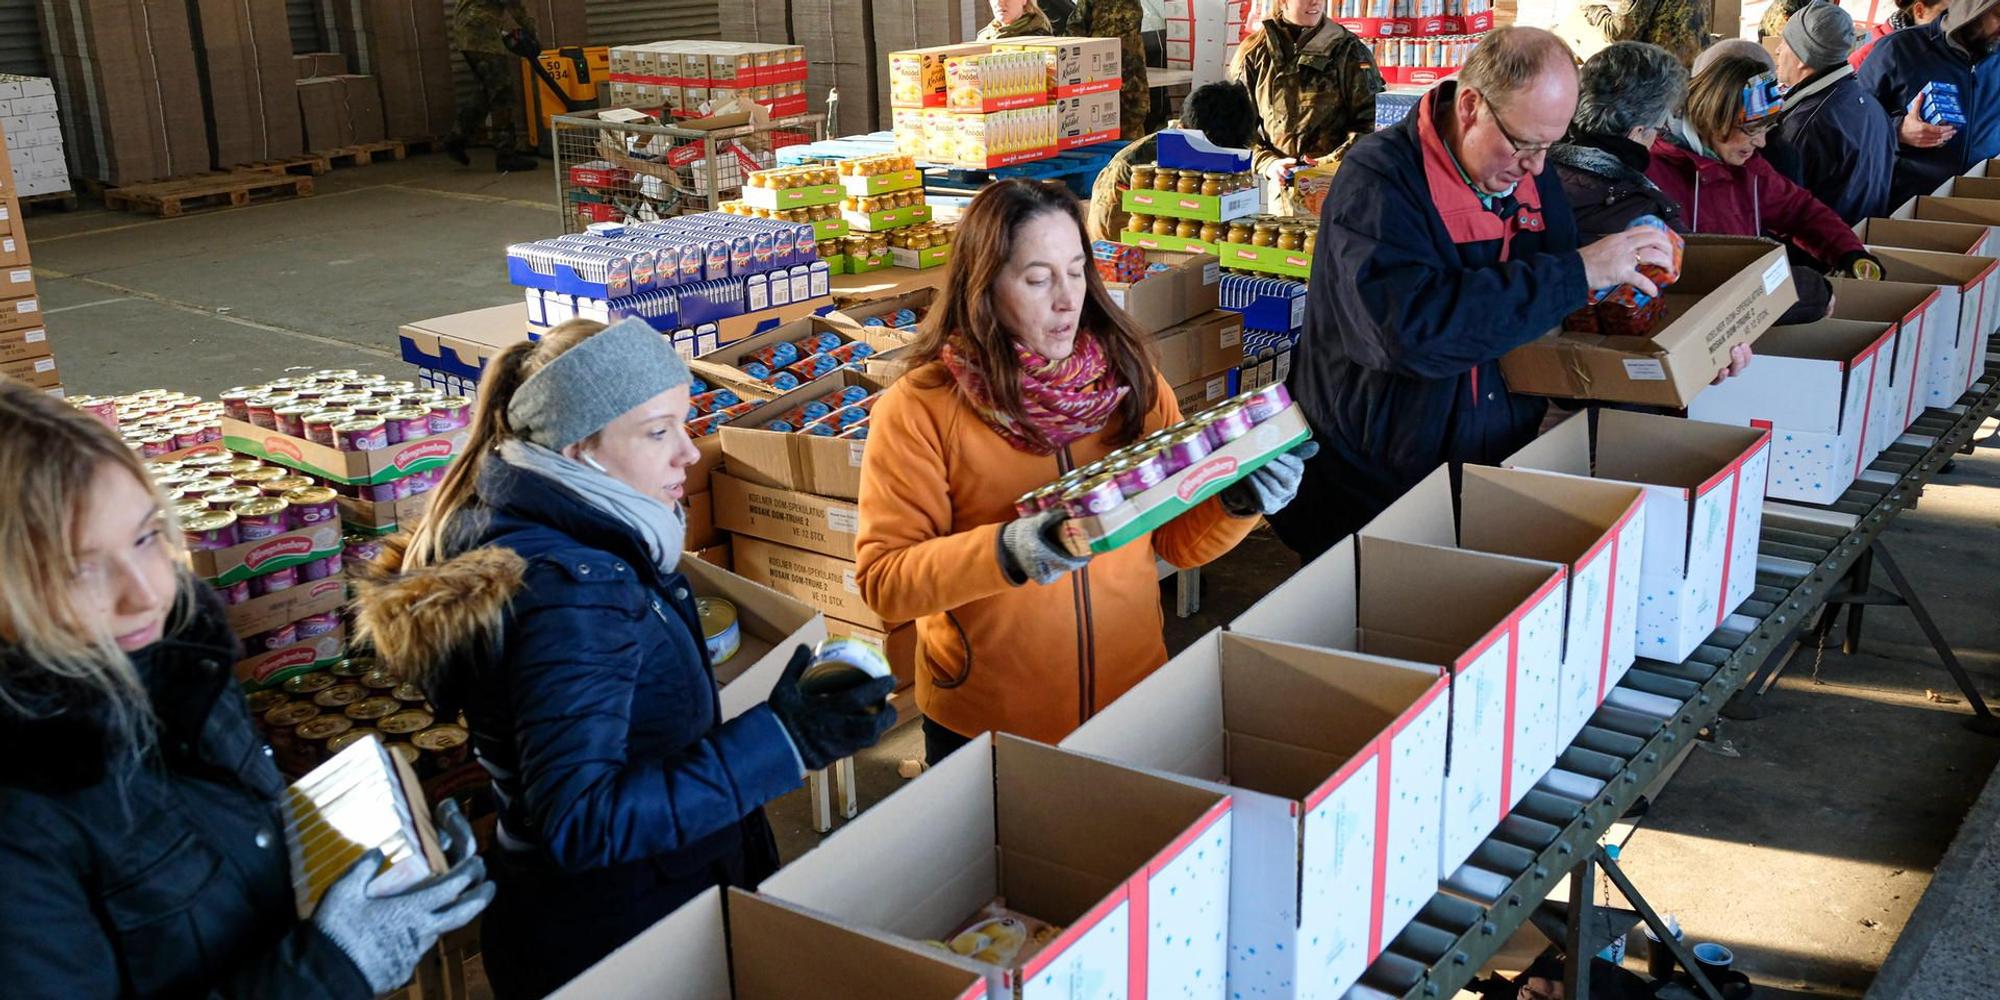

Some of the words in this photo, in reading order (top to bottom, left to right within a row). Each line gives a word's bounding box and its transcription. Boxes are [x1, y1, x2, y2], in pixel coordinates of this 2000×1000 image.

[547, 61, 560, 70] 50
[748, 493, 773, 505] KOELNER
[792, 527, 801, 536] VE
[811, 591, 820, 600] VE
